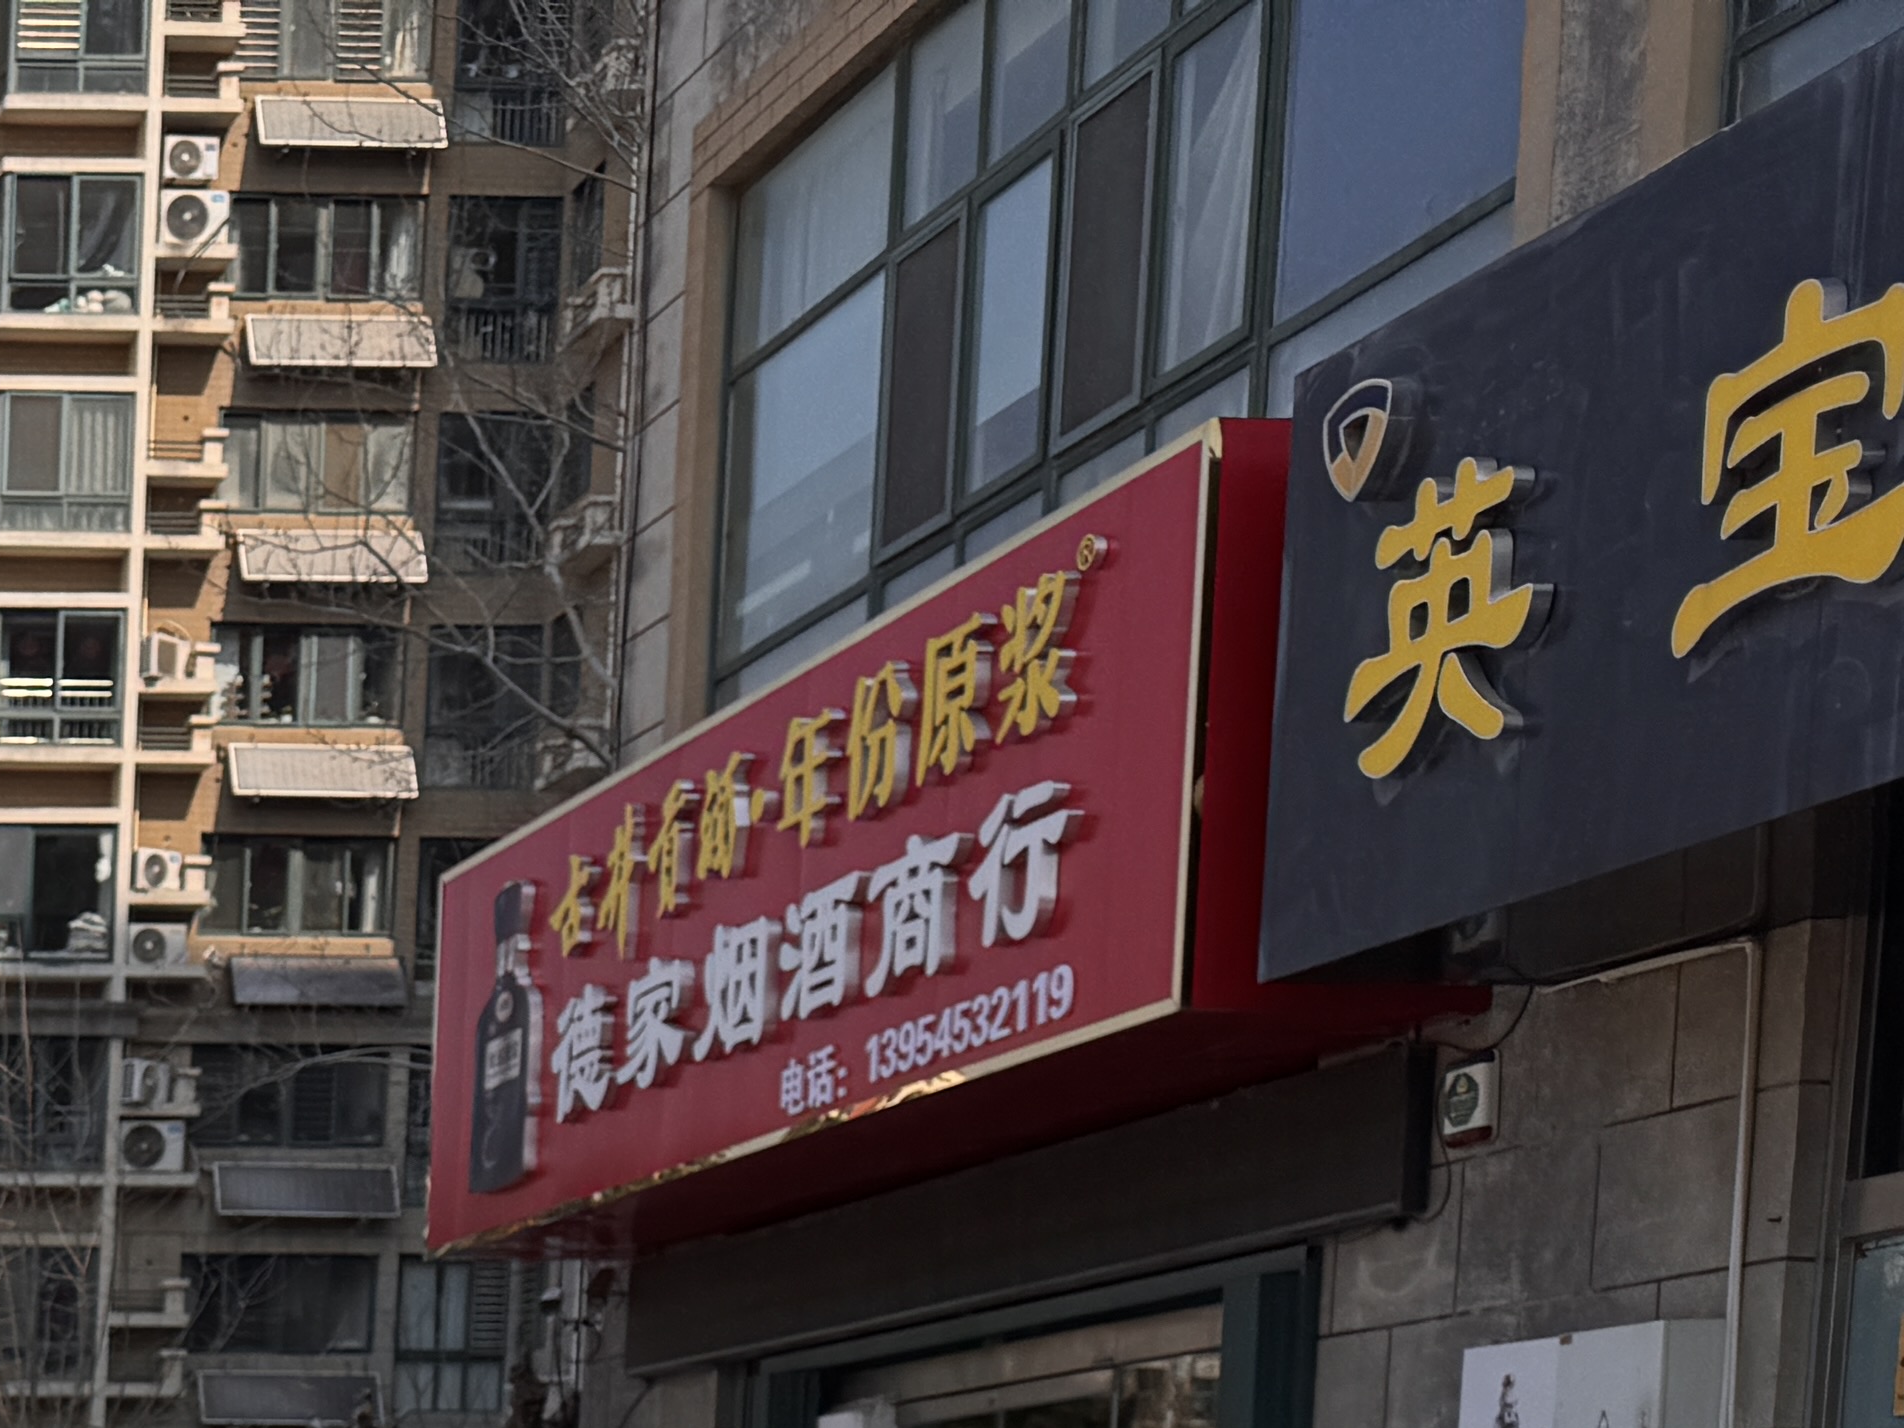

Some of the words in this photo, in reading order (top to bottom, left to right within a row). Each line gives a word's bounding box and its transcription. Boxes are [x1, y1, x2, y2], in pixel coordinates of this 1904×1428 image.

[550, 780, 1074, 1124] 德家烟酒商行
[864, 964, 1075, 1083] 13954532119
